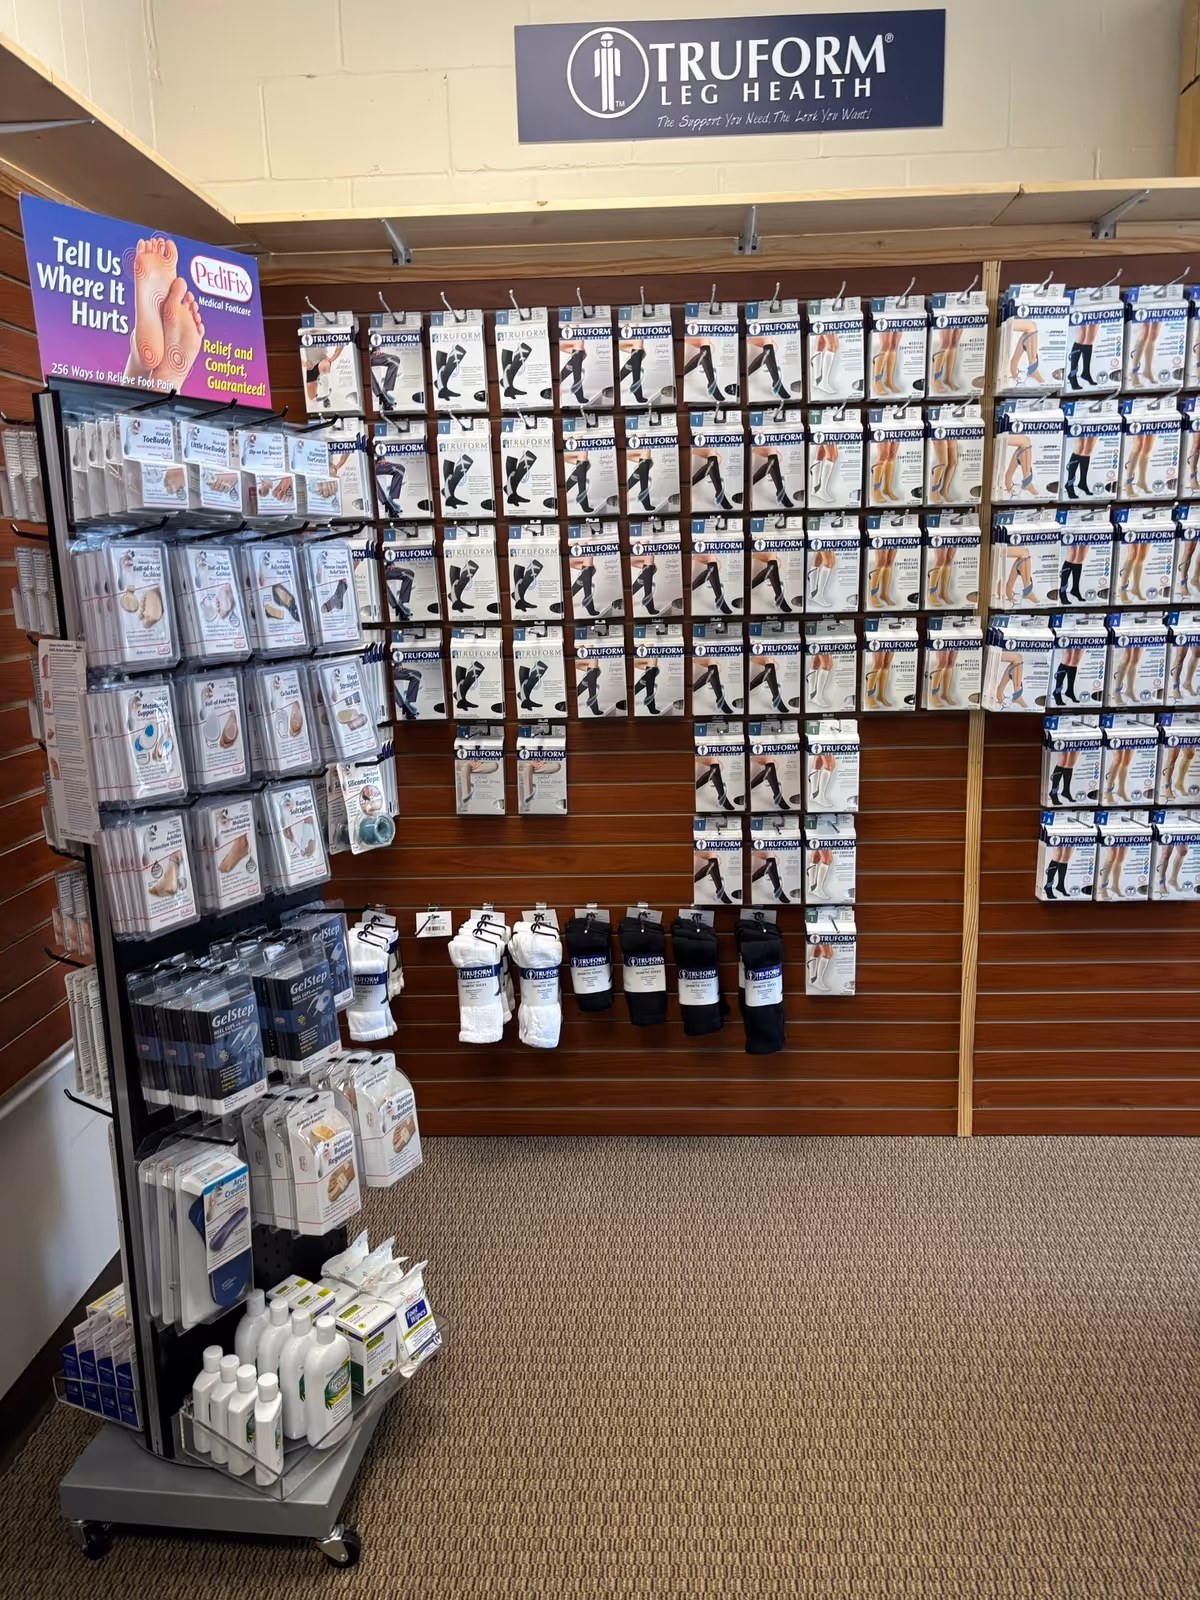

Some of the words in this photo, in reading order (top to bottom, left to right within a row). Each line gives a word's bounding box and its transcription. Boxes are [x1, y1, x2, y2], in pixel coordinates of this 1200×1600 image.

[661, 84, 718, 106] LEG
[743, 78, 871, 102] HEALTH
[657, 115, 674, 128] The
[679, 114, 722, 131] Support
[725, 112, 742, 127] You
[773, 110, 791, 123] The
[795, 109, 818, 122] Look
[821, 109, 838, 123] You
[842, 107, 872, 121] Want!
[52, 236, 90, 269] Tell
[97, 247, 121, 276] Us
[37, 262, 105, 300] Where
[109, 279, 125, 305] It
[198, 297, 224, 311] Medical
[225, 303, 252, 317] Footcare
[1029, 306, 1068, 315] TRUFORM
[71, 300, 129, 335] Hurts
[1083, 310, 1123, 320] TRUFORM
[1147, 308, 1187, 318] TRUFORM
[888, 318, 926, 327] TRUFORM
[949, 316, 987, 325] TRUFORM
[632, 326, 671, 335] TRUFORM
[699, 324, 737, 333] TRUFORM
[760, 322, 799, 332] TRUFORM
[824, 321, 862, 331] TRUFORM
[503, 329, 547, 340] TRUFORM
[573, 327, 611, 336] TRUFORM
[313, 334, 350, 343] TRUFORM
[381, 333, 420, 342] TRUFORM
[439, 331, 481, 342] TRUFORM
[203, 339, 232, 360] Relief
[234, 346, 253, 361] and
[205, 358, 248, 379] Comfort,
[51, 362, 68, 376] 256
[71, 366, 94, 383] Ways
[96, 370, 105, 381] to
[107, 372, 136, 387] Relieve
[138, 376, 155, 389] Foot
[207, 376, 266, 397] Guaranteed!
[1023, 421, 1062, 430] TRUFORM
[1082, 423, 1120, 433] TRUFORM
[1141, 421, 1180, 431] TRUFORM
[885, 430, 923, 439] TRUFORM
[946, 428, 984, 437] TRUFORM
[142, 435, 171, 446] ToeBuddy
[576, 438, 614, 446] TRUFORM
[639, 437, 678, 446] TRUFORM
[705, 435, 743, 444] TRUFORM
[765, 433, 804, 442] TRUFORM
[824, 433, 862, 442] TRUFORM
[190, 441, 204, 450] Little
[204, 443, 228, 454] ToeBuddy
[328, 442, 356, 450] UFORM
[386, 443, 424, 452] TRUFORM
[446, 442, 488, 451] TRUFORM
[510, 438, 551, 448] TRUFORM
[942, 535, 979, 544] TRUFORM
[1021, 532, 1059, 542] TRUFORM
[1074, 532, 1112, 541] TRUFORM
[1136, 531, 1175, 540] TRUFORM
[705, 541, 742, 550] TRUFORM
[765, 539, 802, 549] TRUFORM
[822, 539, 859, 548] TRUFORM
[883, 537, 920, 546] TRUFORM
[582, 543, 619, 552] TRUFORM
[643, 543, 680, 551] TRUFORM
[395, 549, 432, 557] TRUFORM
[452, 548, 493, 557] TRUFORM
[516, 547, 557, 557] TRUFORM
[880, 640, 917, 649] TRUFORM
[943, 639, 981, 648] TRUFORM
[1016, 640, 1052, 649] TRUFORM
[1070, 637, 1106, 645] TRUFORM
[1129, 635, 1166, 645] TRUFORM
[588, 647, 624, 655] TRUFORM
[647, 646, 683, 655] TRUFORM
[705, 645, 742, 653] TRUFORM
[763, 643, 800, 652] TRUFORM
[819, 642, 856, 651] TRUFORM
[403, 651, 440, 660] TRUFORM
[459, 650, 499, 659] TRUFORM
[521, 649, 561, 659] TRUFORM
[347, 672, 358, 680] Heel
[1065, 739, 1101, 747] TRUFORM
[1121, 738, 1157, 746] TRUFORM
[1179, 737, 1200, 745] TRUF
[708, 745, 744, 753] TRUFORM
[763, 743, 798, 752] TRUFORM
[821, 744, 859, 752] TRUFORM
[764, 840, 799, 848] TRUFORM
[820, 839, 855, 848] TRUFORM
[820, 935, 855, 943] TRUFORM
[536, 969, 558, 977] TRUFOR
[290, 970, 328, 995] GelStep
[212, 1003, 254, 1028] GelStep
[234, 1174, 247, 1185] Arch
[225, 1182, 247, 1198] Cradles
[406, 1306, 419, 1320] Foot
[410, 1309, 427, 1324] Wipes
